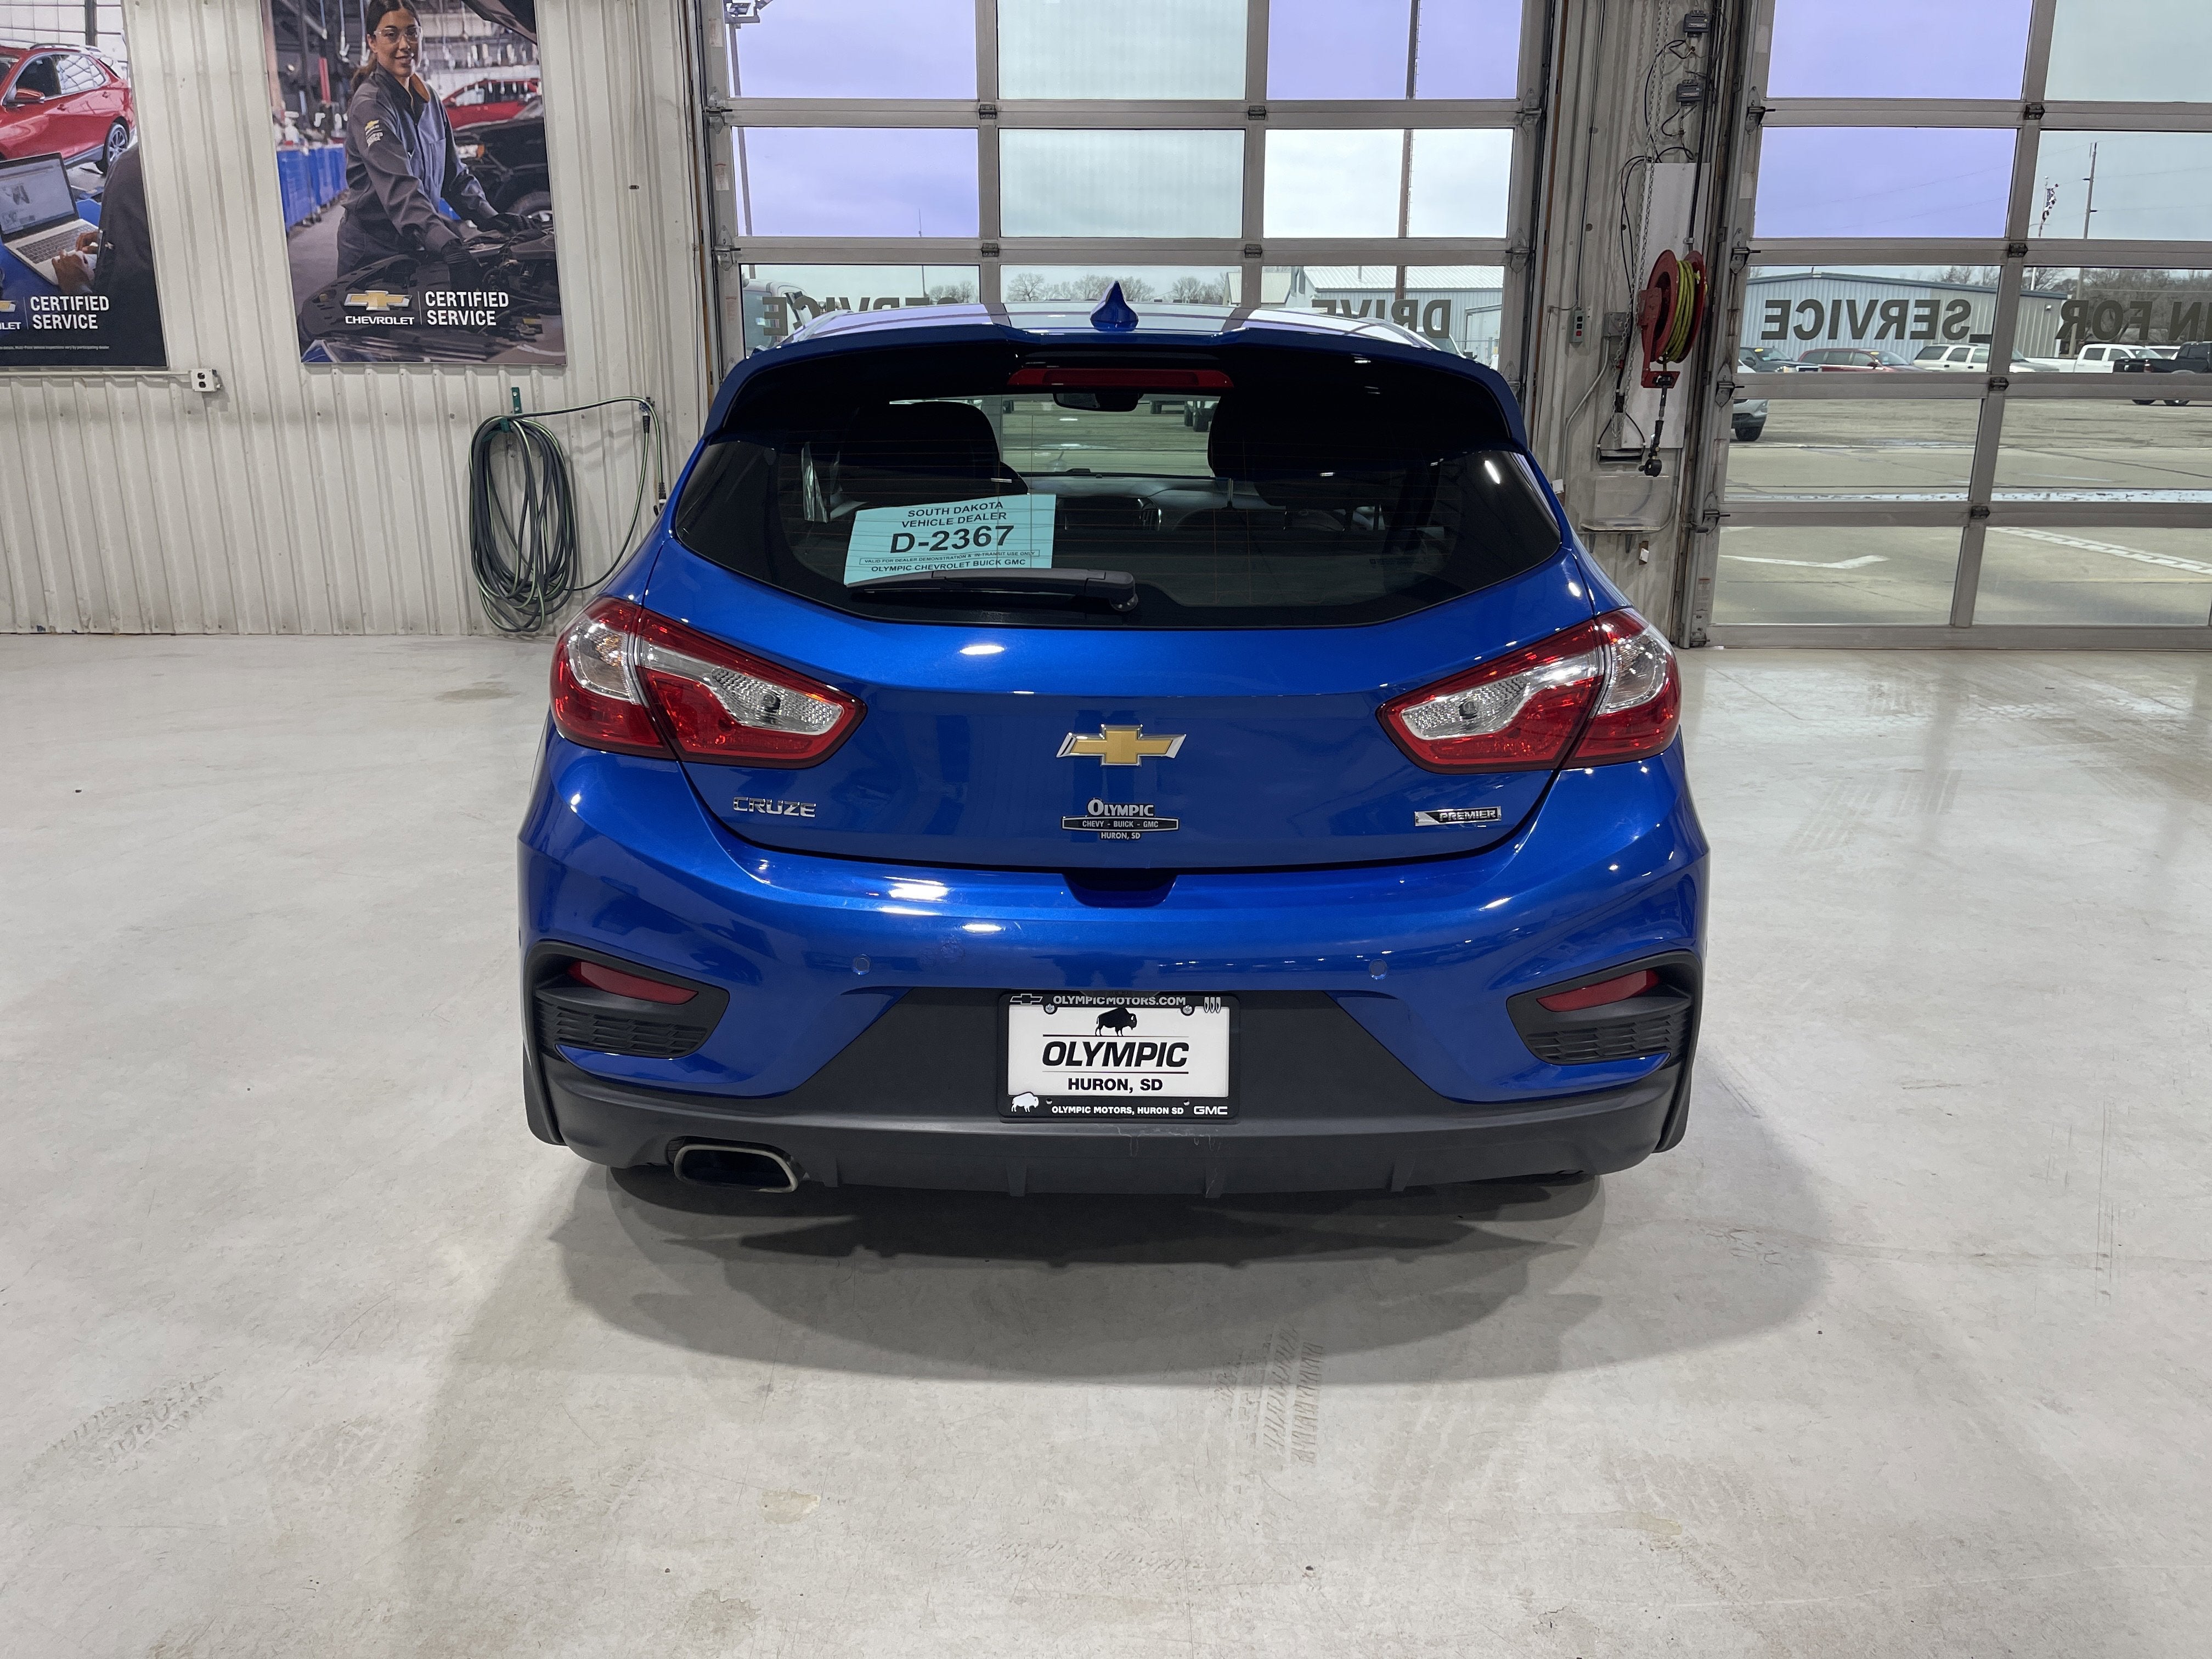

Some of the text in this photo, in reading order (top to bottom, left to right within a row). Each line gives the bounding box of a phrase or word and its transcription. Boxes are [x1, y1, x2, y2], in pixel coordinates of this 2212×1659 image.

[30, 296, 110, 311] CERTIFIED
[425, 291, 509, 307] CERTIFIED
[32, 314, 98, 329] SERVICE
[345, 316, 415, 325] CHEVROLET
[427, 310, 496, 326] SERVICE
[908, 501, 1003, 517] SOUTH DAKOTA
[901, 512, 1007, 528] VEHICLE DEALER
[890, 525, 1014, 554] D-2367
[915, 561, 970, 571] CHEVROLET
[733, 796, 816, 817] CRUZE
[1439, 809, 1496, 821] PREMIER
[1042, 1041, 1189, 1067] OLYMPIC
[1068, 1078, 1163, 1093] HURON, SD
[1052, 1106, 1094, 1114] OLYMPIC
[1094, 1106, 1135, 1115] MOTORS,
[1193, 1106, 1228, 1115] GMC
